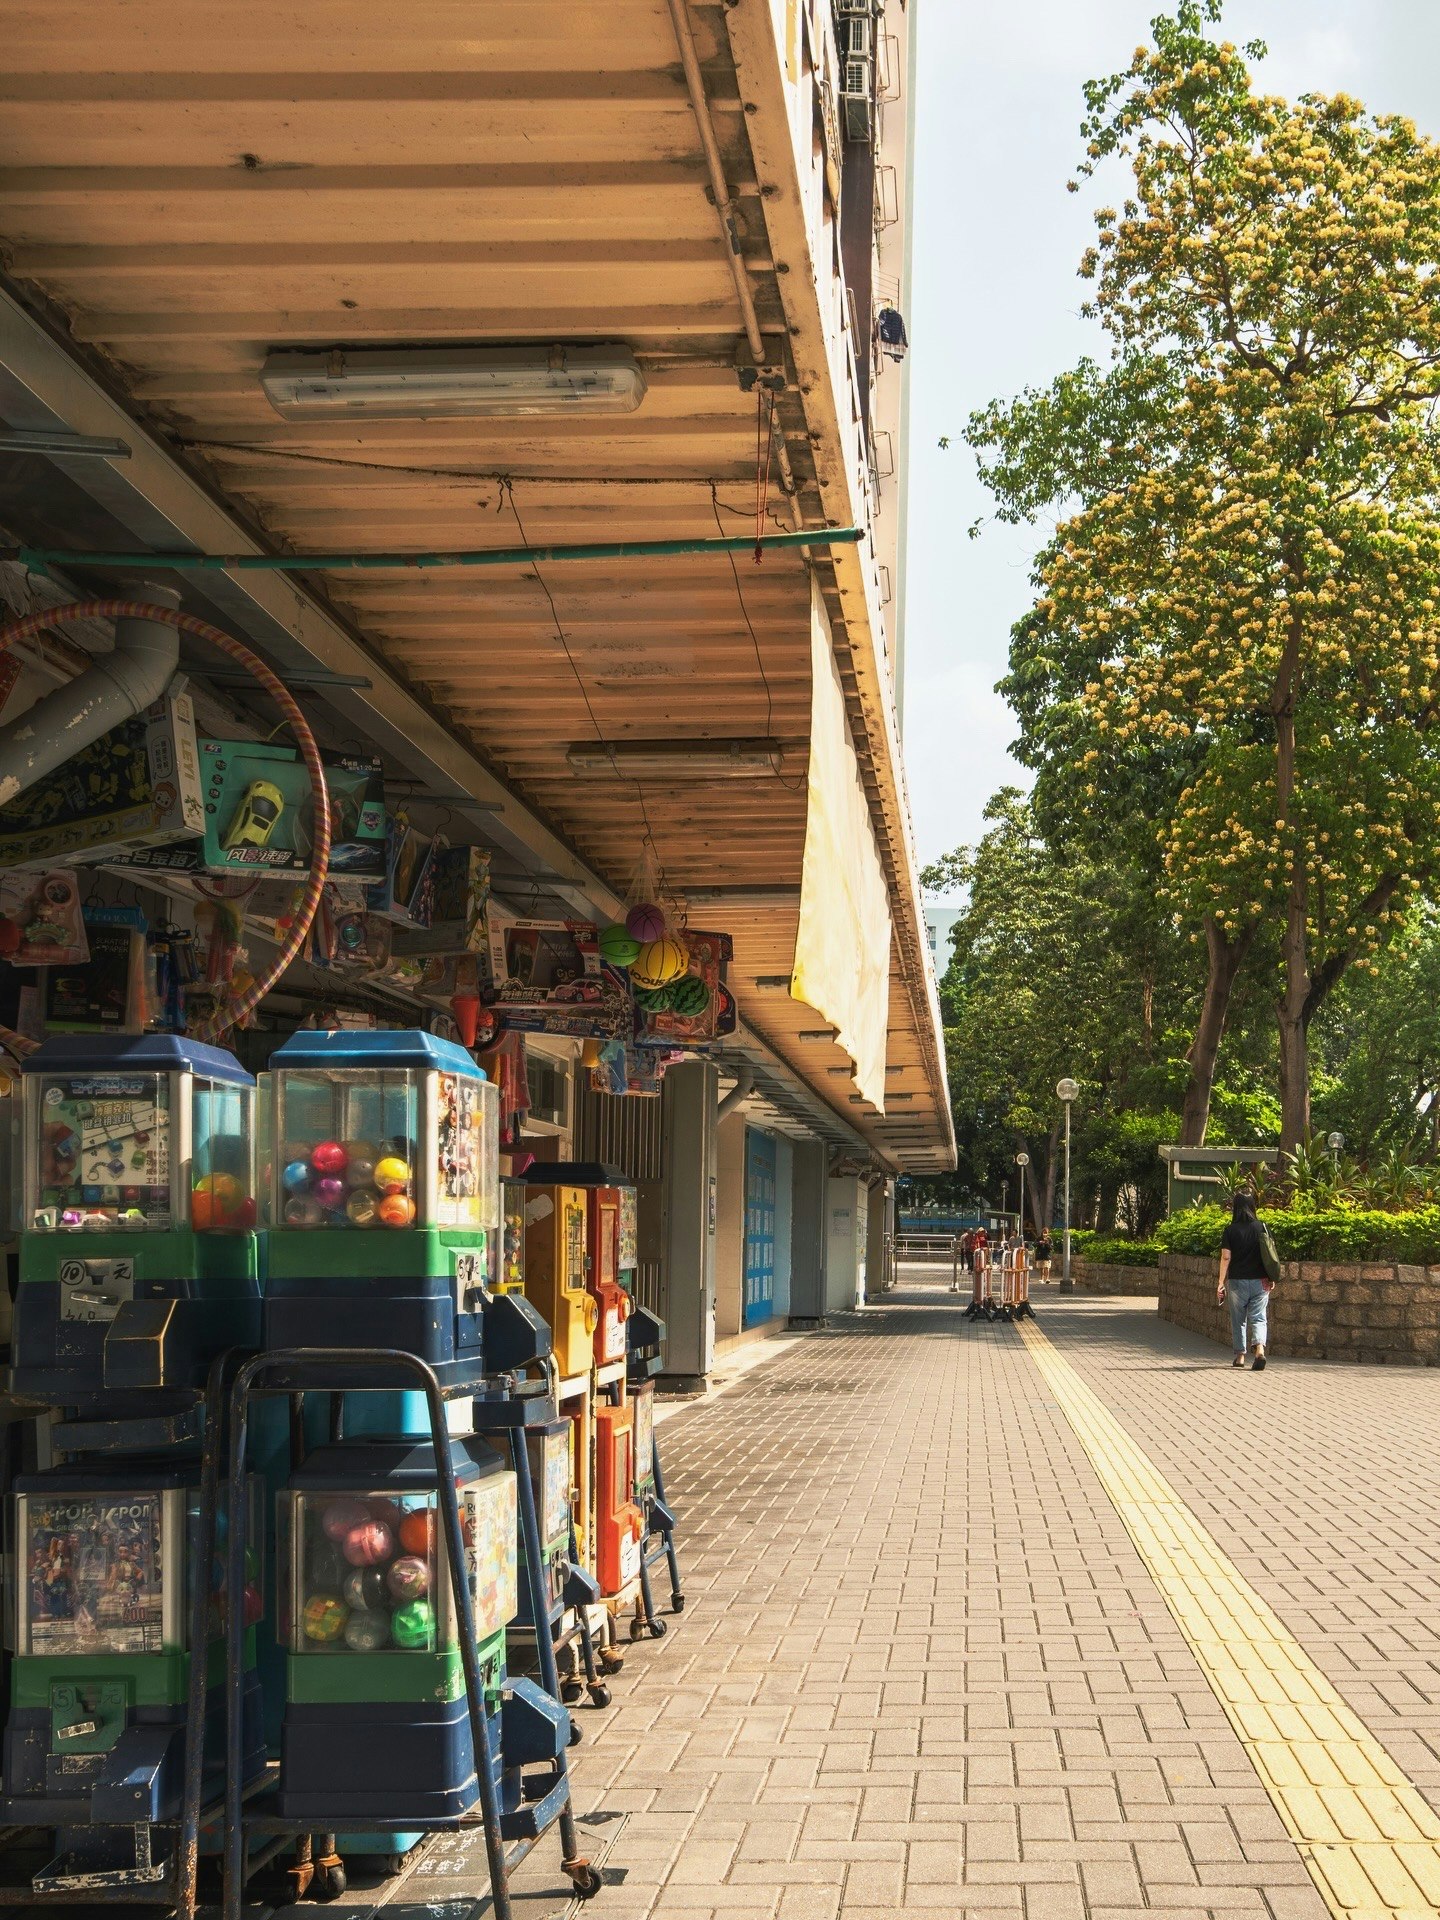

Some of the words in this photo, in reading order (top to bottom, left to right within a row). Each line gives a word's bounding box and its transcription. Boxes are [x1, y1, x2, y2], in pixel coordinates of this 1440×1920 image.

[181, 738, 196, 781] LEYI
[96, 937, 129, 946] SCRATCH
[62, 1264, 82, 1283] 10
[113, 1263, 131, 1280] 元
[121, 1606, 146, 1622] 400
